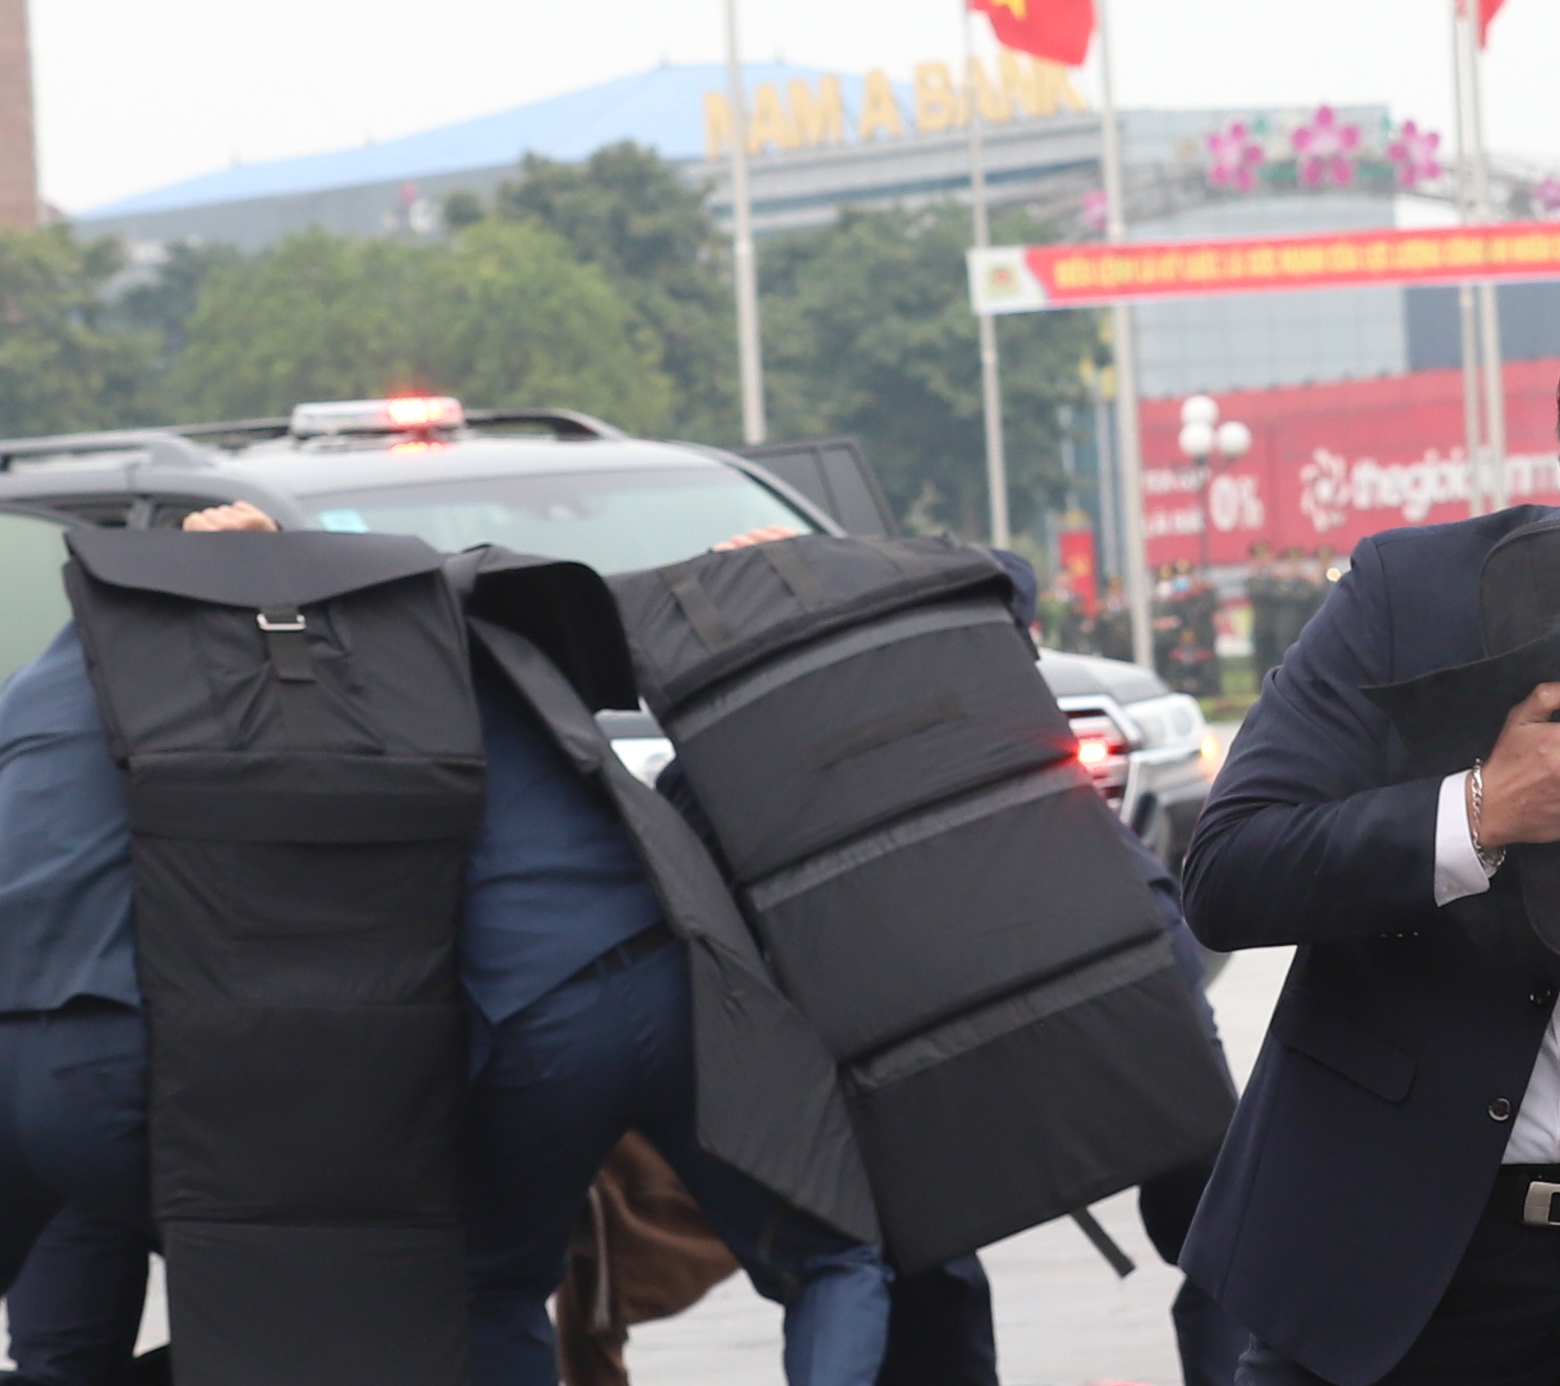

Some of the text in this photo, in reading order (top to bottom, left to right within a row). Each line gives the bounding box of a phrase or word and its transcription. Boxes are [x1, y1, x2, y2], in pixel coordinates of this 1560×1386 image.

[702, 48, 1090, 160] NAM A BANK
[1210, 475, 1264, 531] 0%
